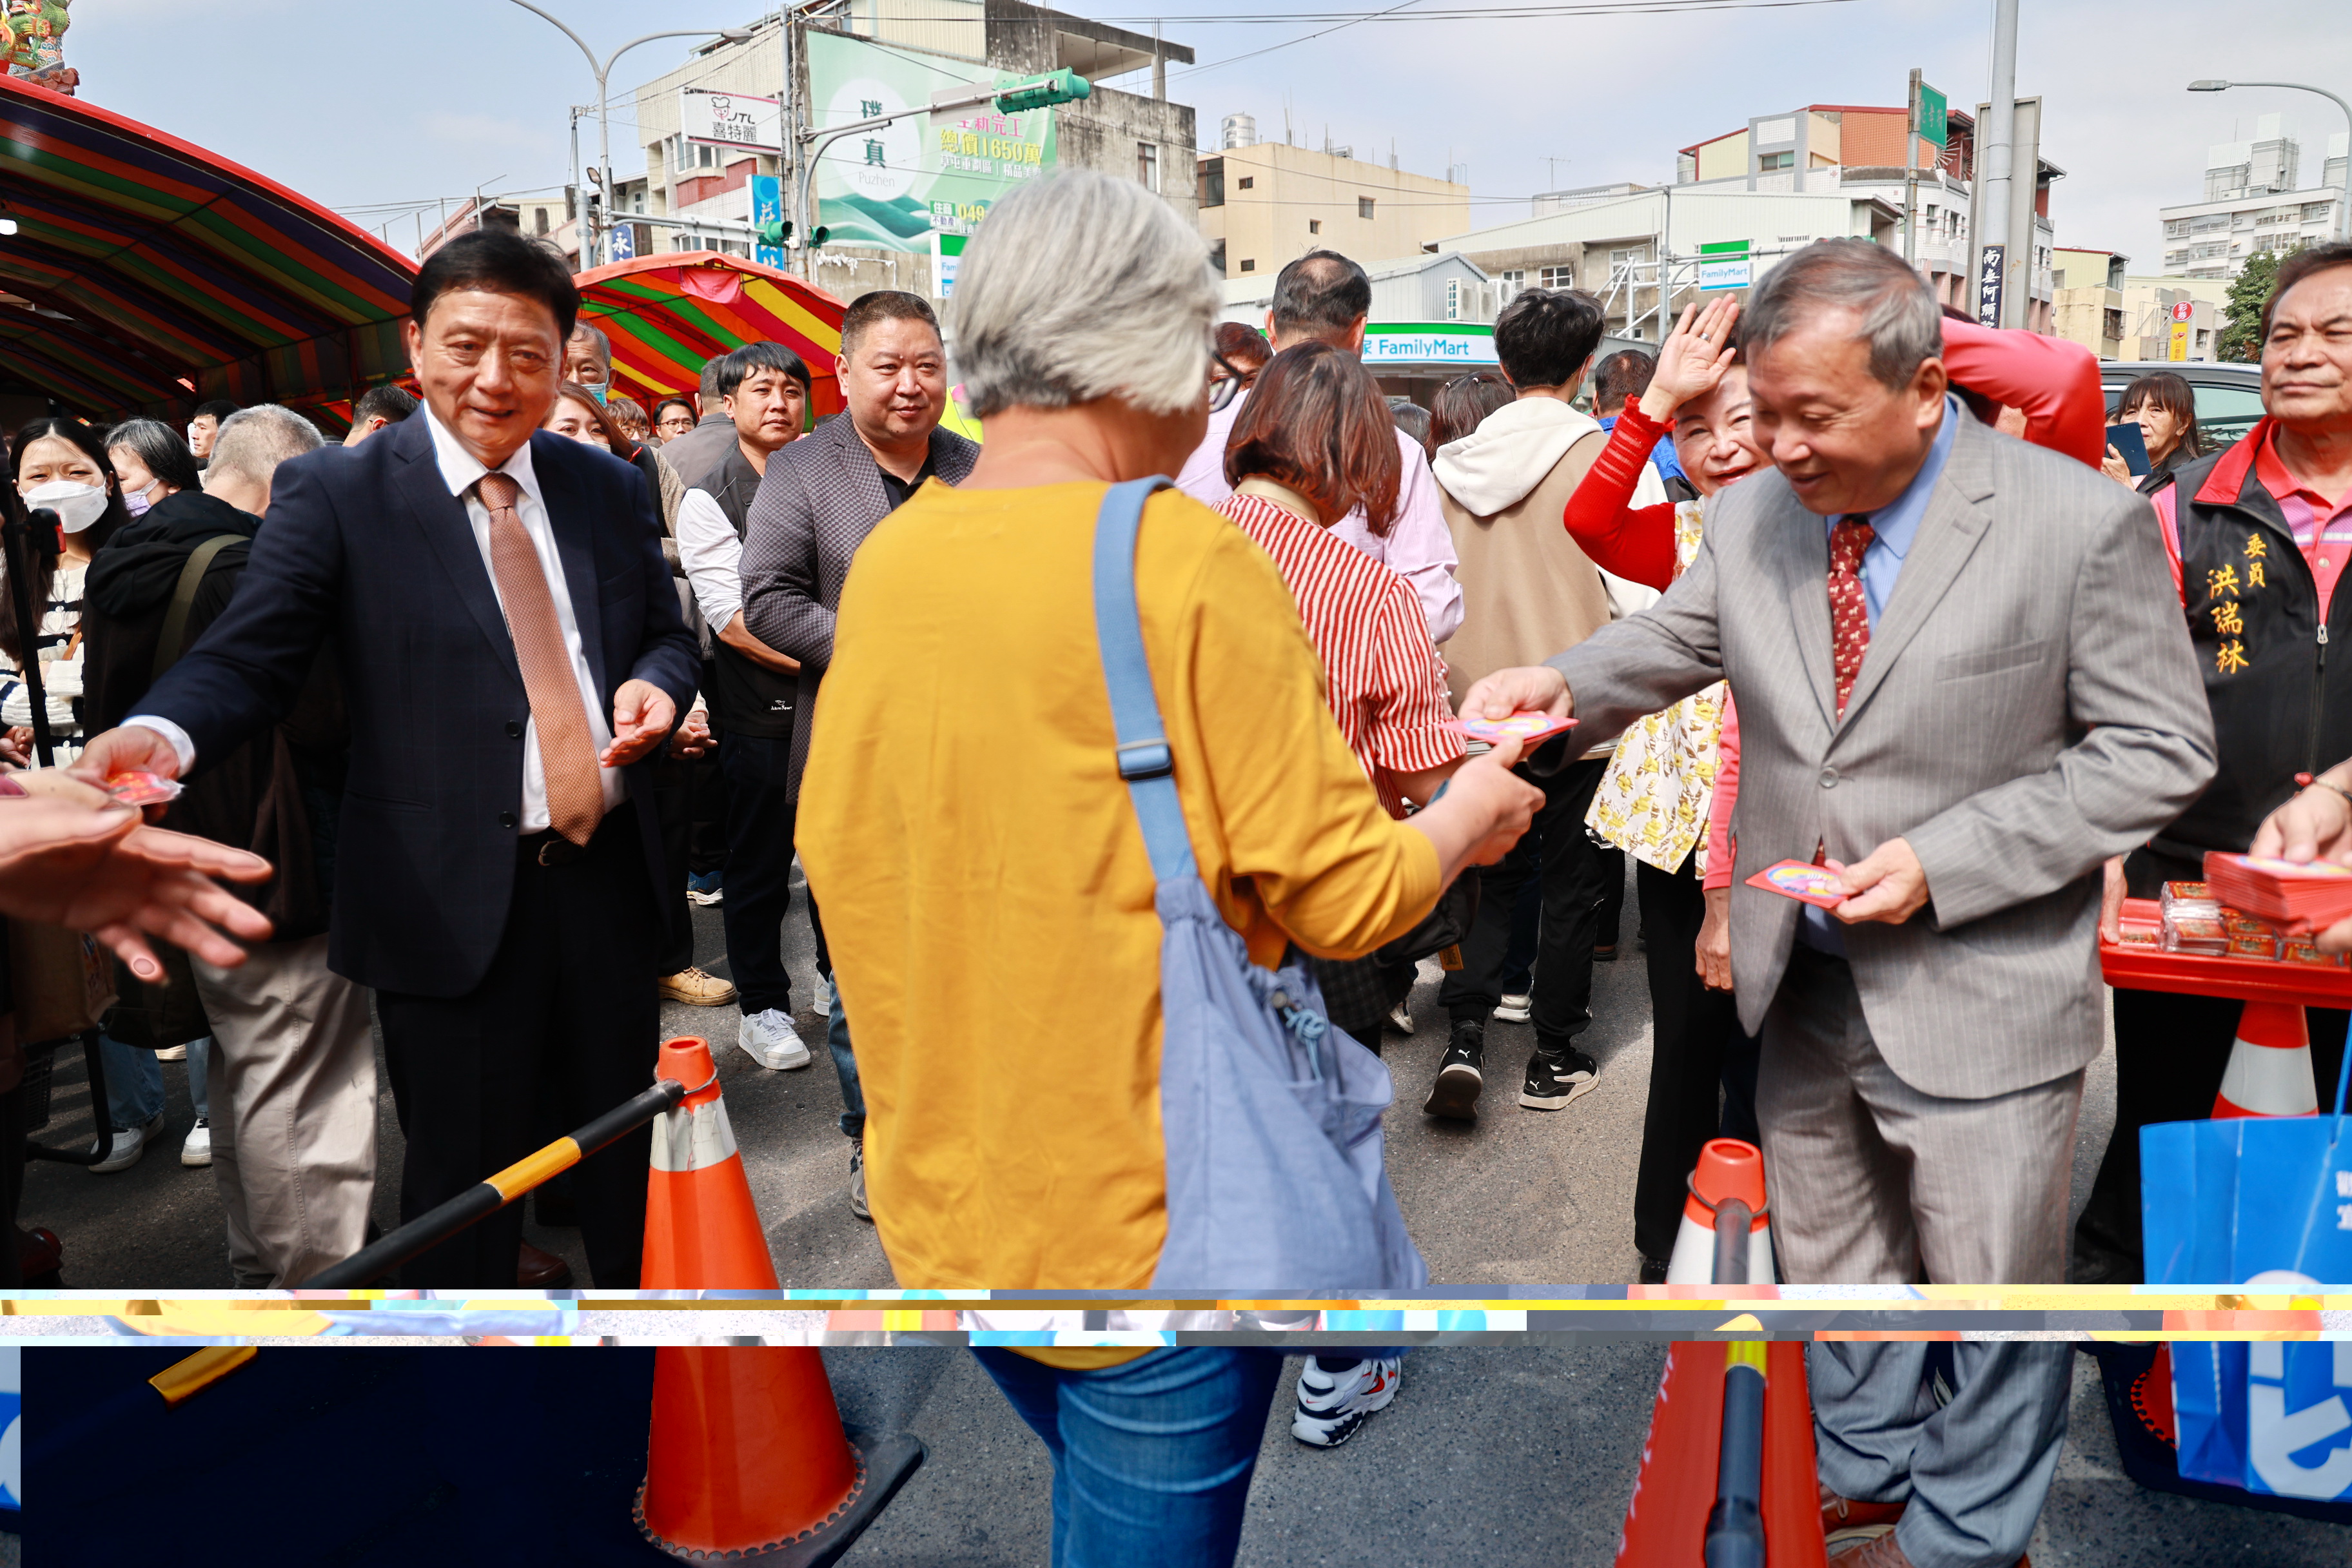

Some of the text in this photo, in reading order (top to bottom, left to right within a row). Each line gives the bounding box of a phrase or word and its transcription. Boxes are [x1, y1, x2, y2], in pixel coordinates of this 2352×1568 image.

[712, 121, 757, 142] 喜特麗
[939, 128, 1042, 166] 總價1650萬
[859, 172, 895, 187] Puzhen
[933, 201, 953, 215] 住商
[932, 215, 955, 226] 不動產
[1701, 268, 1748, 278] FamilyMart
[1379, 339, 1469, 357] FamilyMart
[2243, 533, 2268, 587] 委員
